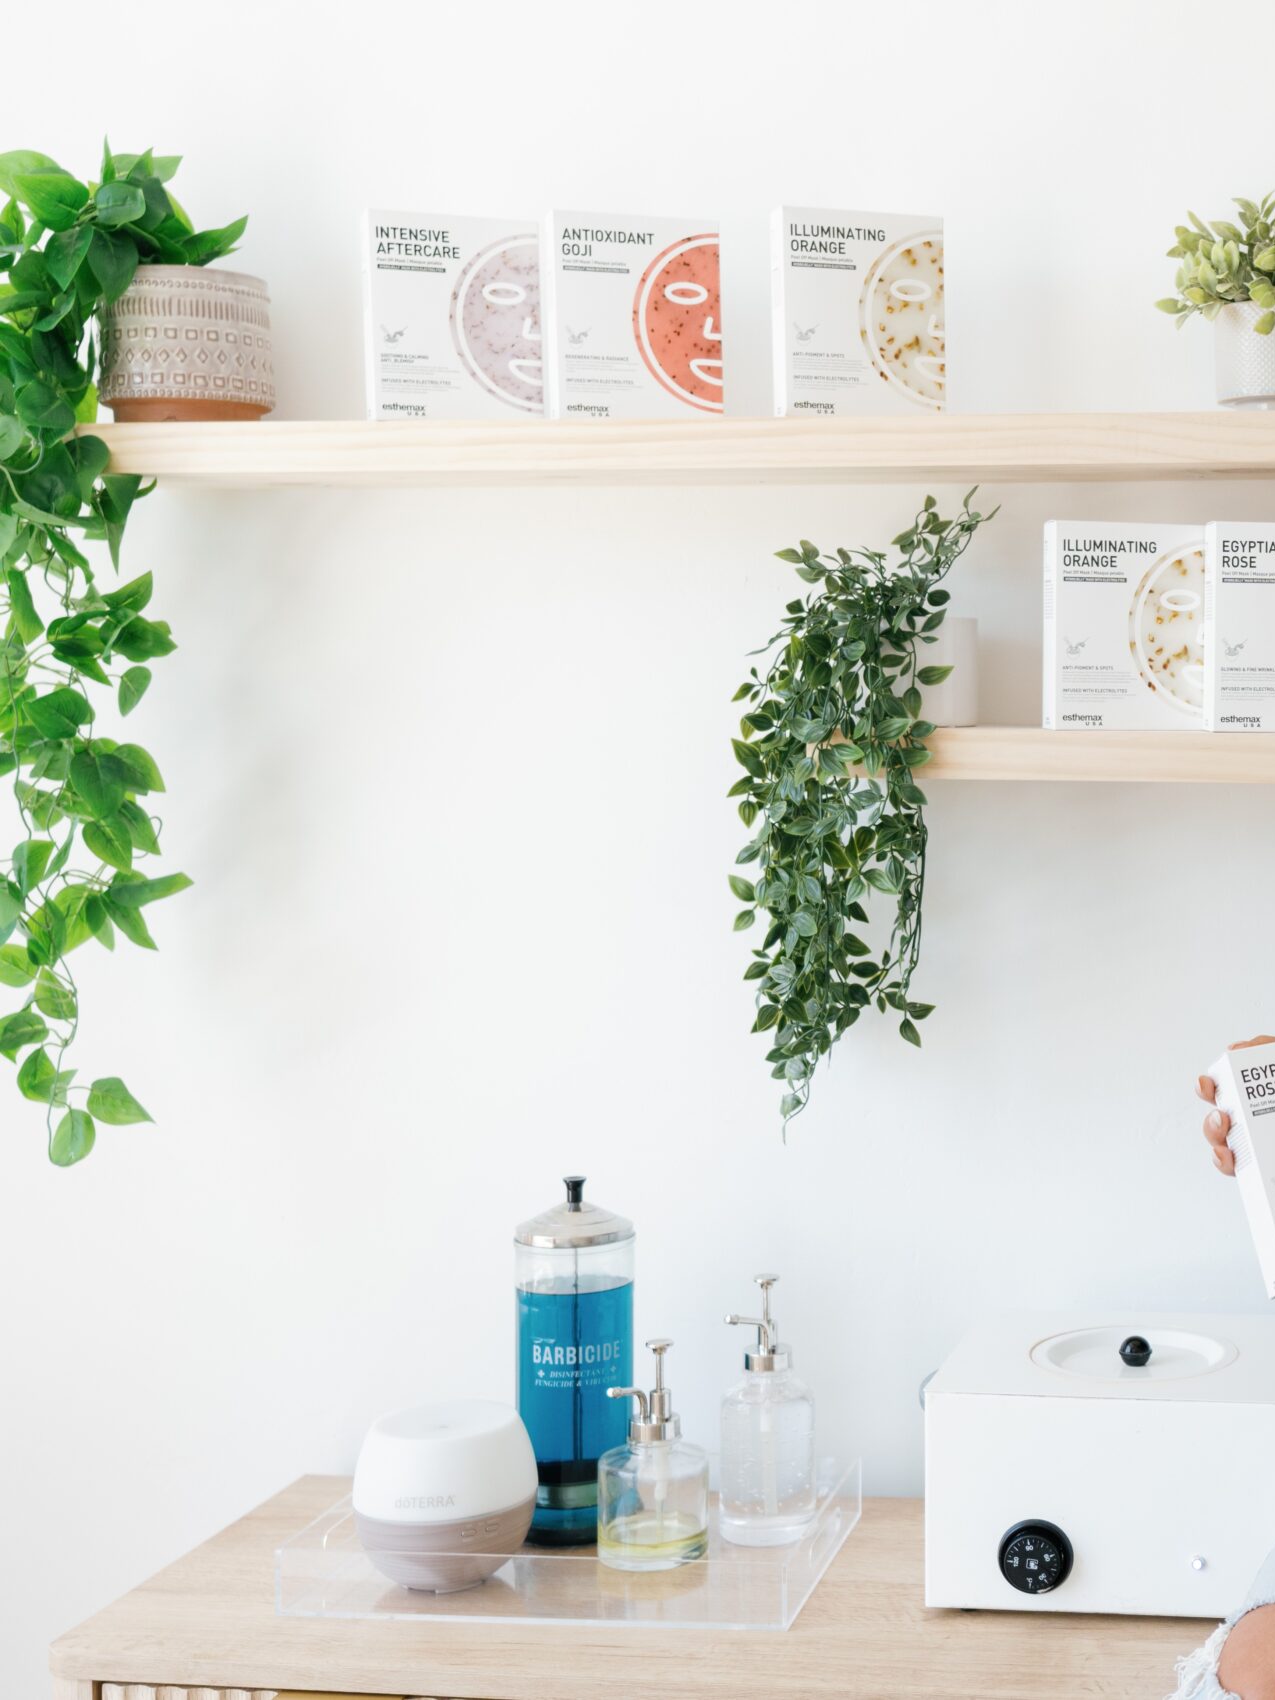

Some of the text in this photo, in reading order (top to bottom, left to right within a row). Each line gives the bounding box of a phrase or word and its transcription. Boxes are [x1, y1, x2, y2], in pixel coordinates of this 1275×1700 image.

[376, 226, 450, 243] INTENSIVE
[562, 228, 654, 245] ANTIOXIDANT
[791, 224, 885, 241] ILLUMINATING
[377, 242, 460, 259] AFTERCARE
[562, 244, 592, 256] GOJI
[791, 240, 846, 254] ORANGE
[383, 402, 425, 411] esthemax
[568, 404, 608, 413] esthemax
[795, 401, 834, 410] esthemax
[1063, 539, 1157, 553] ILLUMINATING
[1063, 555, 1117, 567] ORANGE
[1223, 556, 1256, 568] ROSE
[1063, 713, 1102, 722] esthemax
[1221, 715, 1260, 724] esthemax
[533, 1340, 621, 1365] BARBICIDE
[535, 1379, 573, 1388] FUNGICIDE
